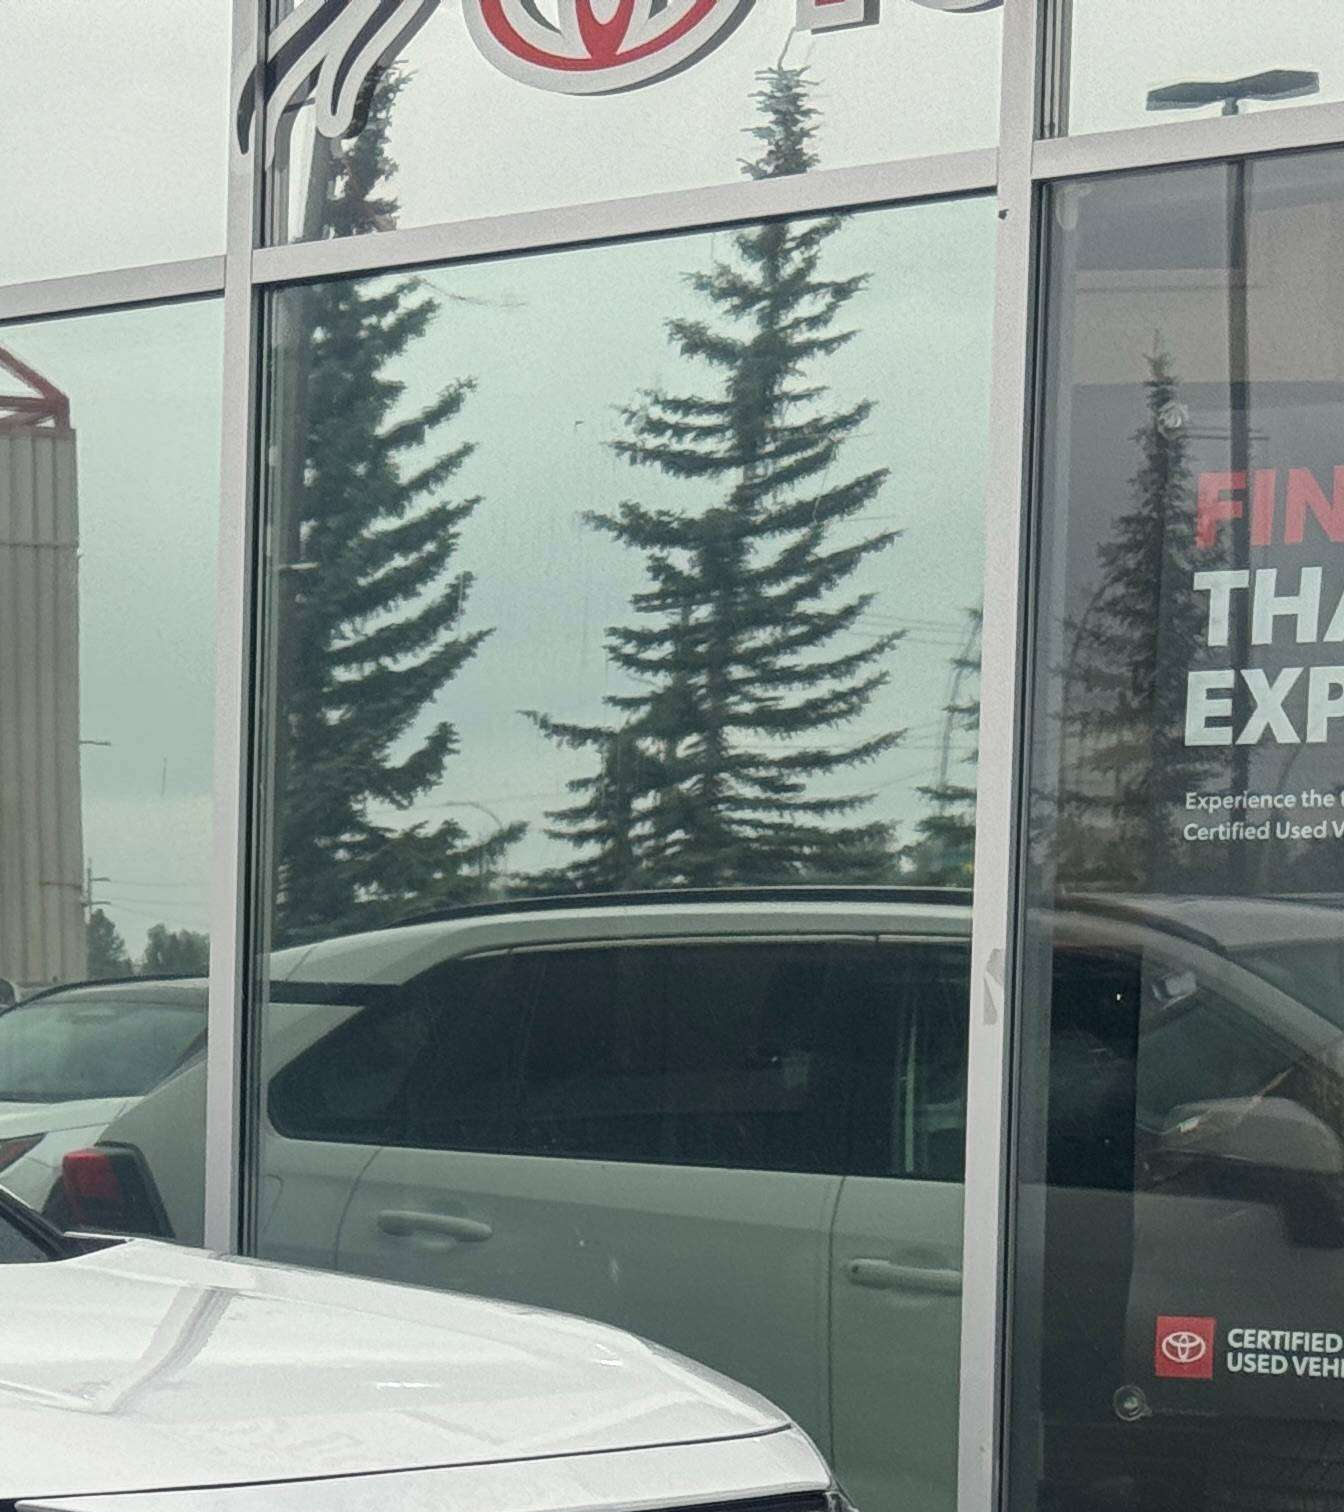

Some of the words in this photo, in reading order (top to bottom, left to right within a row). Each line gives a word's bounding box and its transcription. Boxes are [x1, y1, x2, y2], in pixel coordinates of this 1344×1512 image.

[1185, 791, 1296, 814] Experience
[1301, 789, 1334, 808] the
[1183, 820, 1270, 841] Certified
[1276, 820, 1327, 839] Used
[1228, 1328, 1343, 1353] CERTIFIED
[1227, 1352, 1288, 1376] USED
